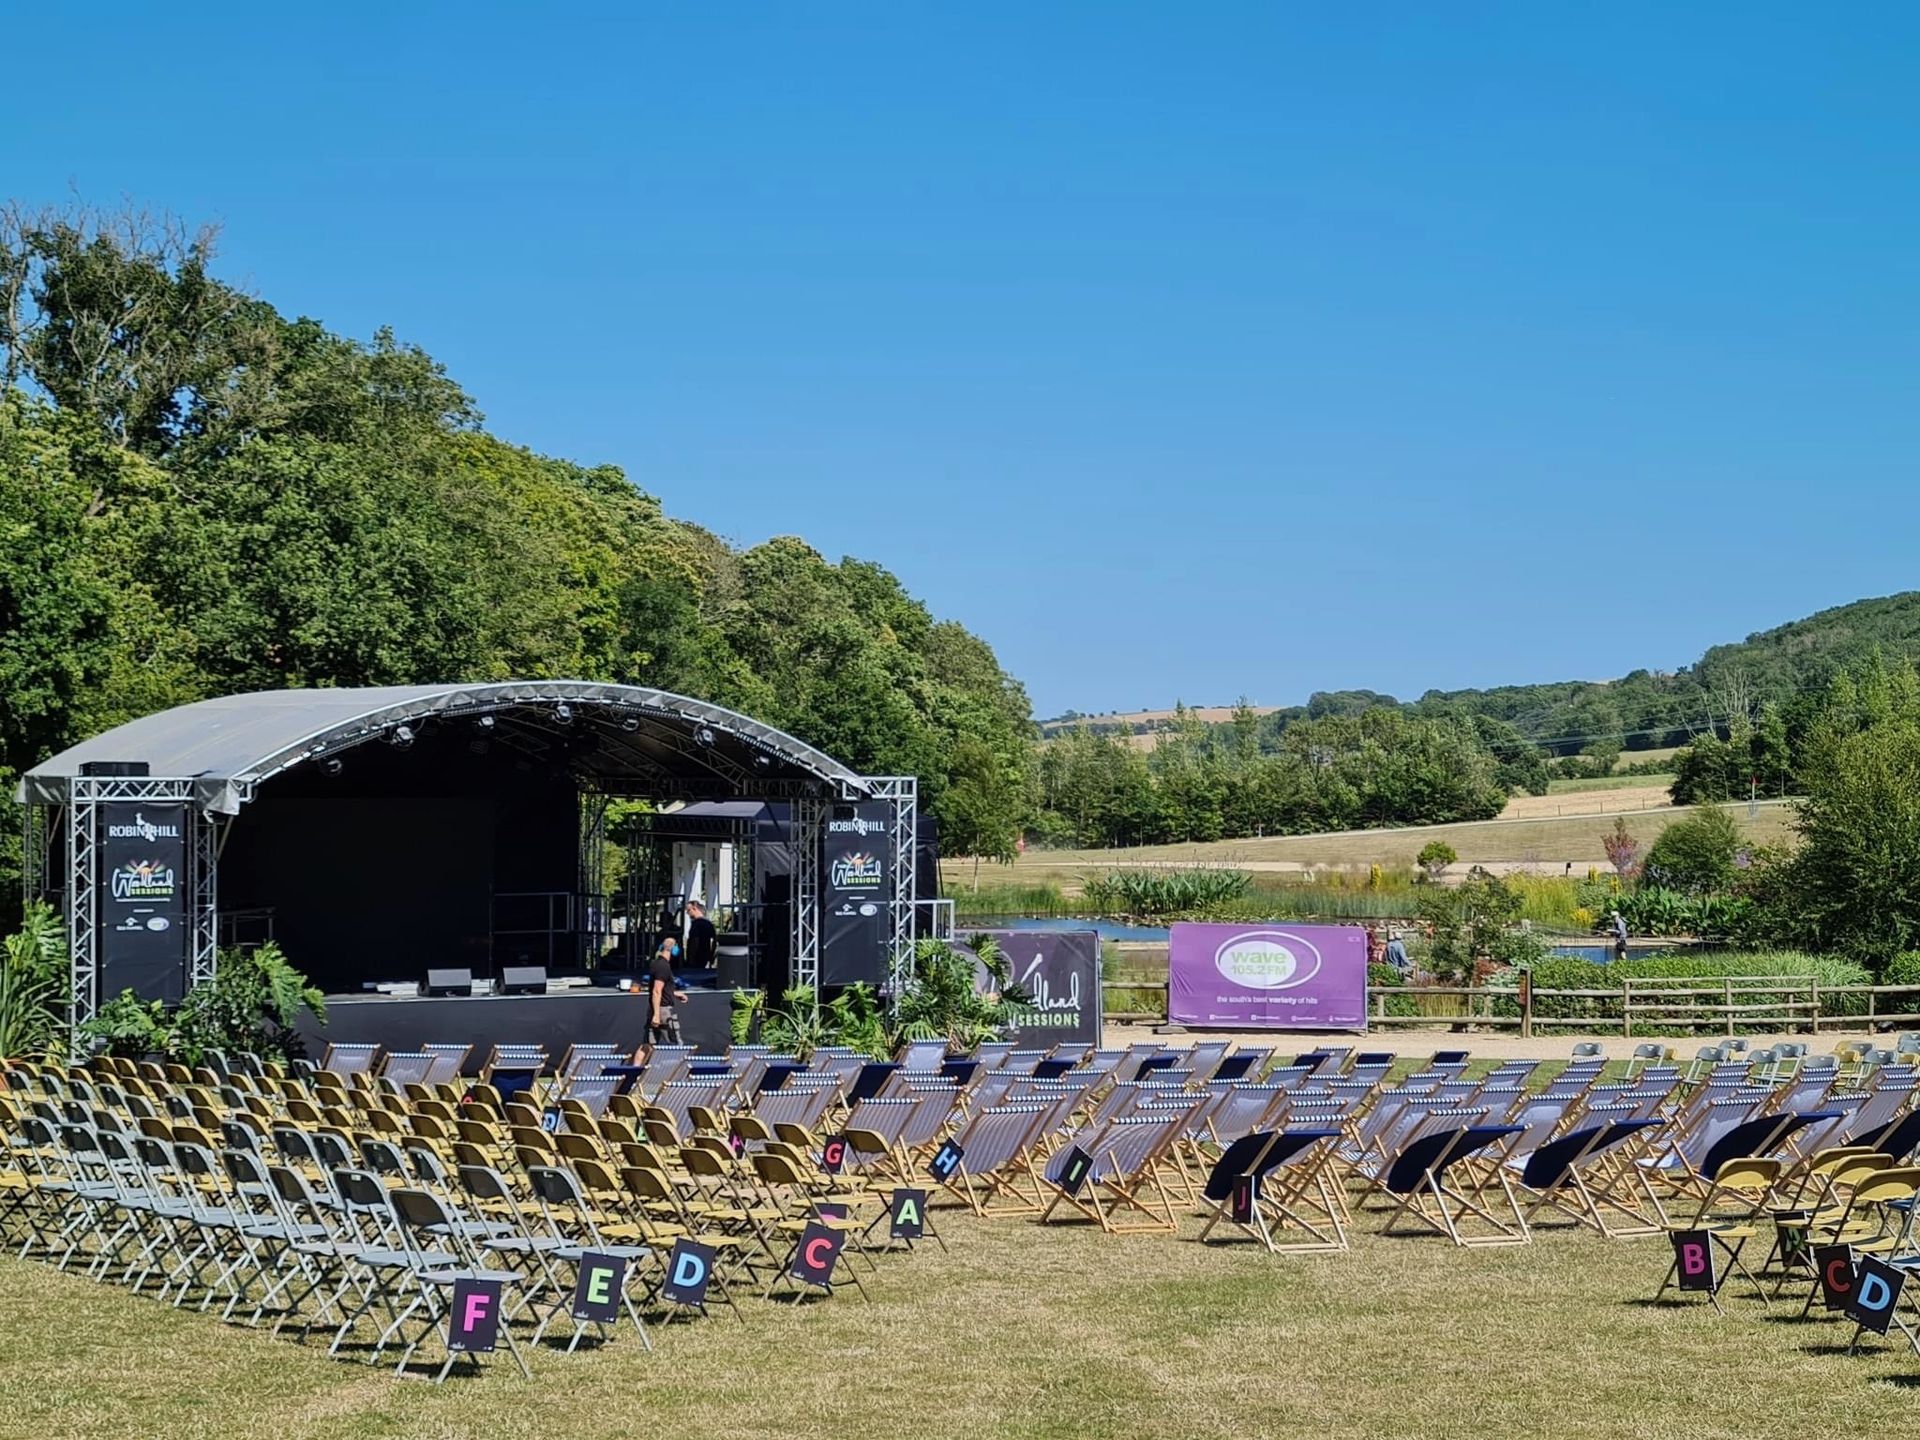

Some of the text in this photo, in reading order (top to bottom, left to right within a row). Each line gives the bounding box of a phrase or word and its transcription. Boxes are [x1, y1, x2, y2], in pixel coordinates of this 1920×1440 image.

[109, 825, 179, 837] ROBIN HILL
[829, 820, 885, 832] ROBIN HILL
[1231, 952, 1287, 964] wave
[1269, 996, 1297, 1006] variety
[1306, 996, 1318, 1005] hits
[1018, 1012, 1080, 1028] SESSIONS
[826, 1143, 842, 1164] G
[935, 1146, 958, 1174] H
[895, 1198, 920, 1226] A
[1238, 1186, 1246, 1210] J
[805, 1238, 833, 1269] C
[1683, 1243, 1706, 1276] B
[672, 1252, 706, 1288] D
[1826, 1259, 1850, 1293] C
[586, 1267, 615, 1305] E
[1857, 1272, 1891, 1311] D
[463, 1294, 491, 1333] F
